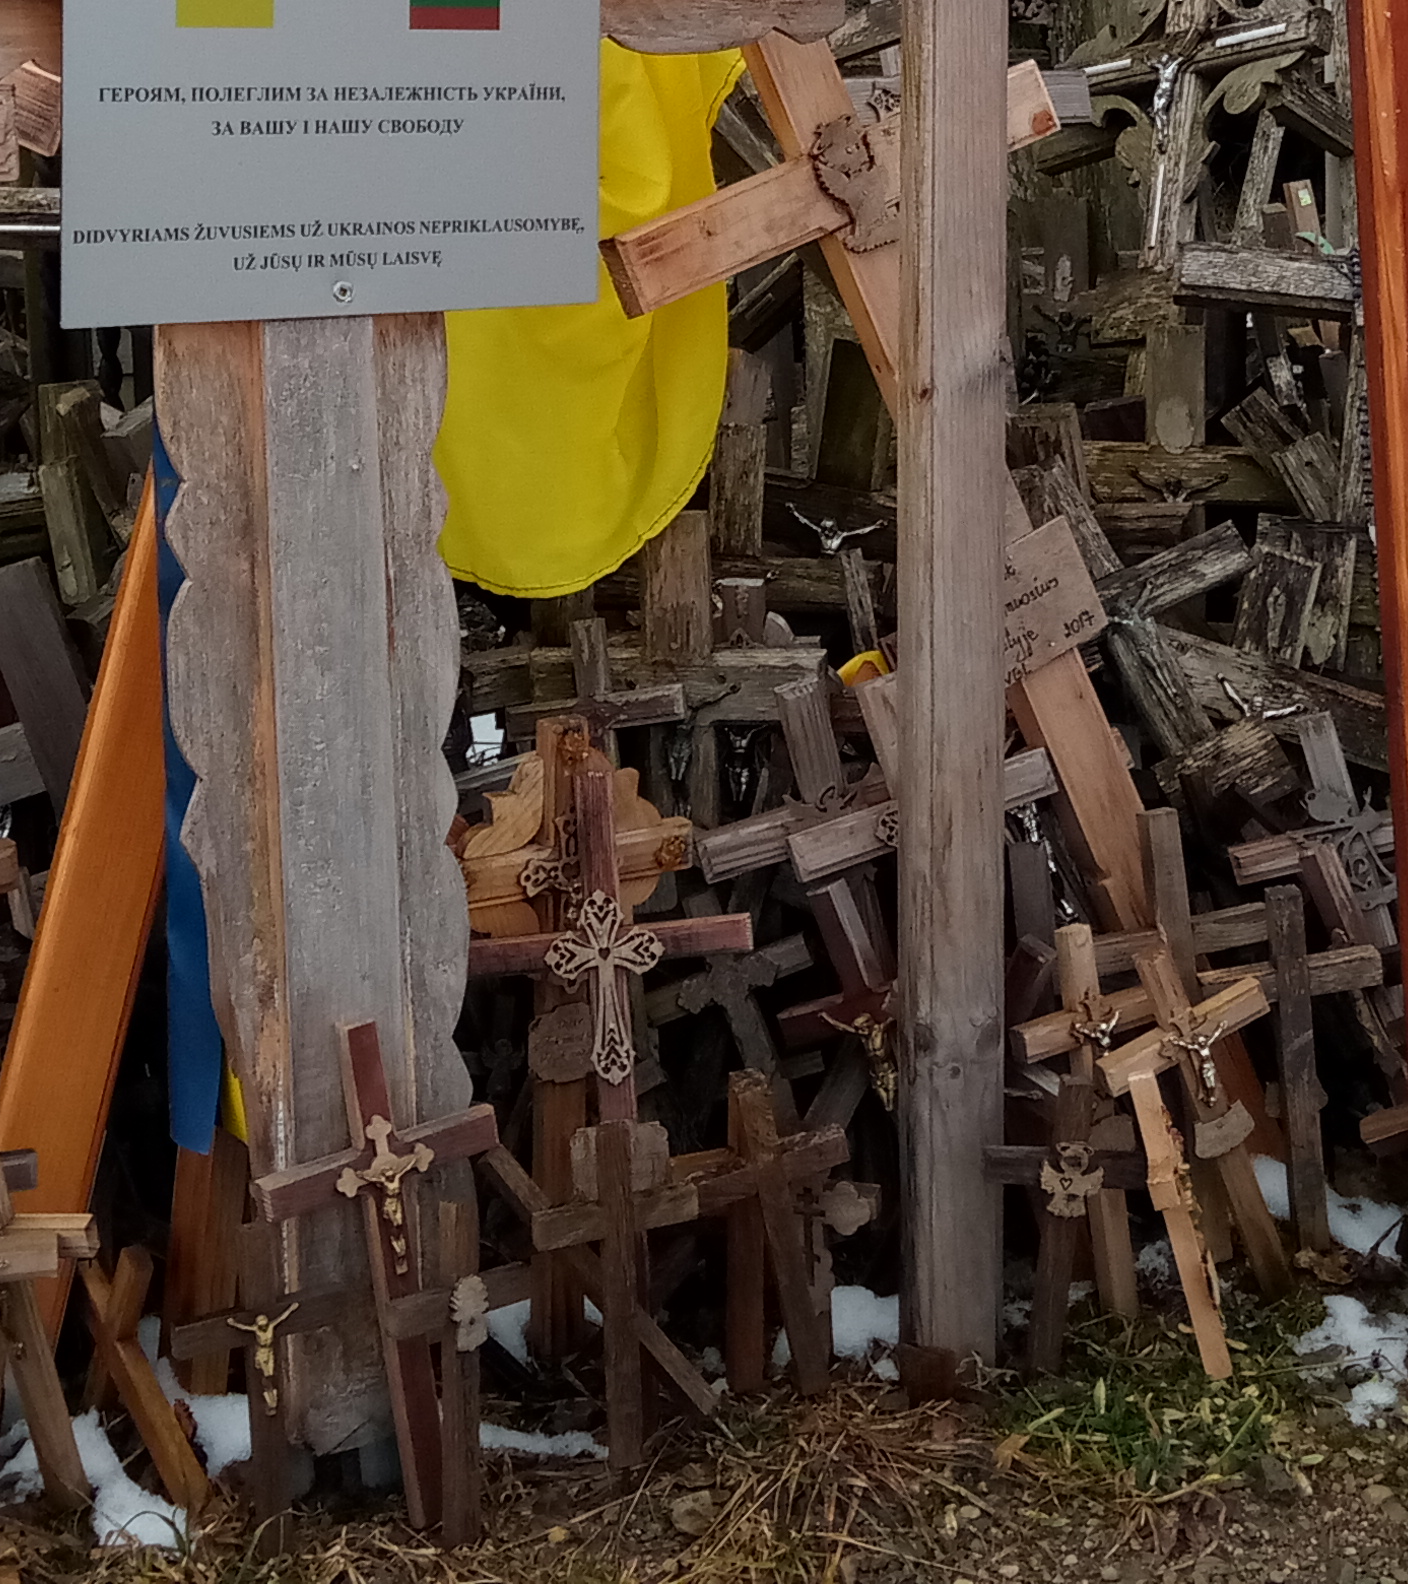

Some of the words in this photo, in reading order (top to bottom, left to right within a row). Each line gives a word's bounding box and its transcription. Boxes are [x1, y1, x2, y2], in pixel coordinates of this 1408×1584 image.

[98, 87, 187, 106] ГЕРОЯМ,
[190, 87, 302, 104] ПОЛЕГЛИМ
[305, 86, 329, 102] ЗА
[333, 86, 478, 103] НЕЗАЛЕЖНІСТЬ
[482, 83, 566, 104] УКРАЇНИ,
[211, 121, 235, 136] ЗА
[239, 120, 298, 135] ВАШУ
[303, 119, 310, 135] І
[314, 119, 374, 135] НАШУ
[377, 118, 465, 136] СВОБОДУ
[72, 226, 190, 244] DIDVYRIAMS
[193, 221, 296, 242] ŽUVUSIEMS
[300, 220, 324, 238] UŽ
[327, 221, 415, 237] UKRAINOS
[418, 218, 586, 237] NEPRIKLAUSOMYBĘ,
[233, 252, 257, 270] UŽ
[260, 251, 303, 272] JŪSŲ
[307, 253, 326, 268] IR
[329, 250, 379, 271] MŪSŲ
[382, 250, 443, 267] LAISVĘ
